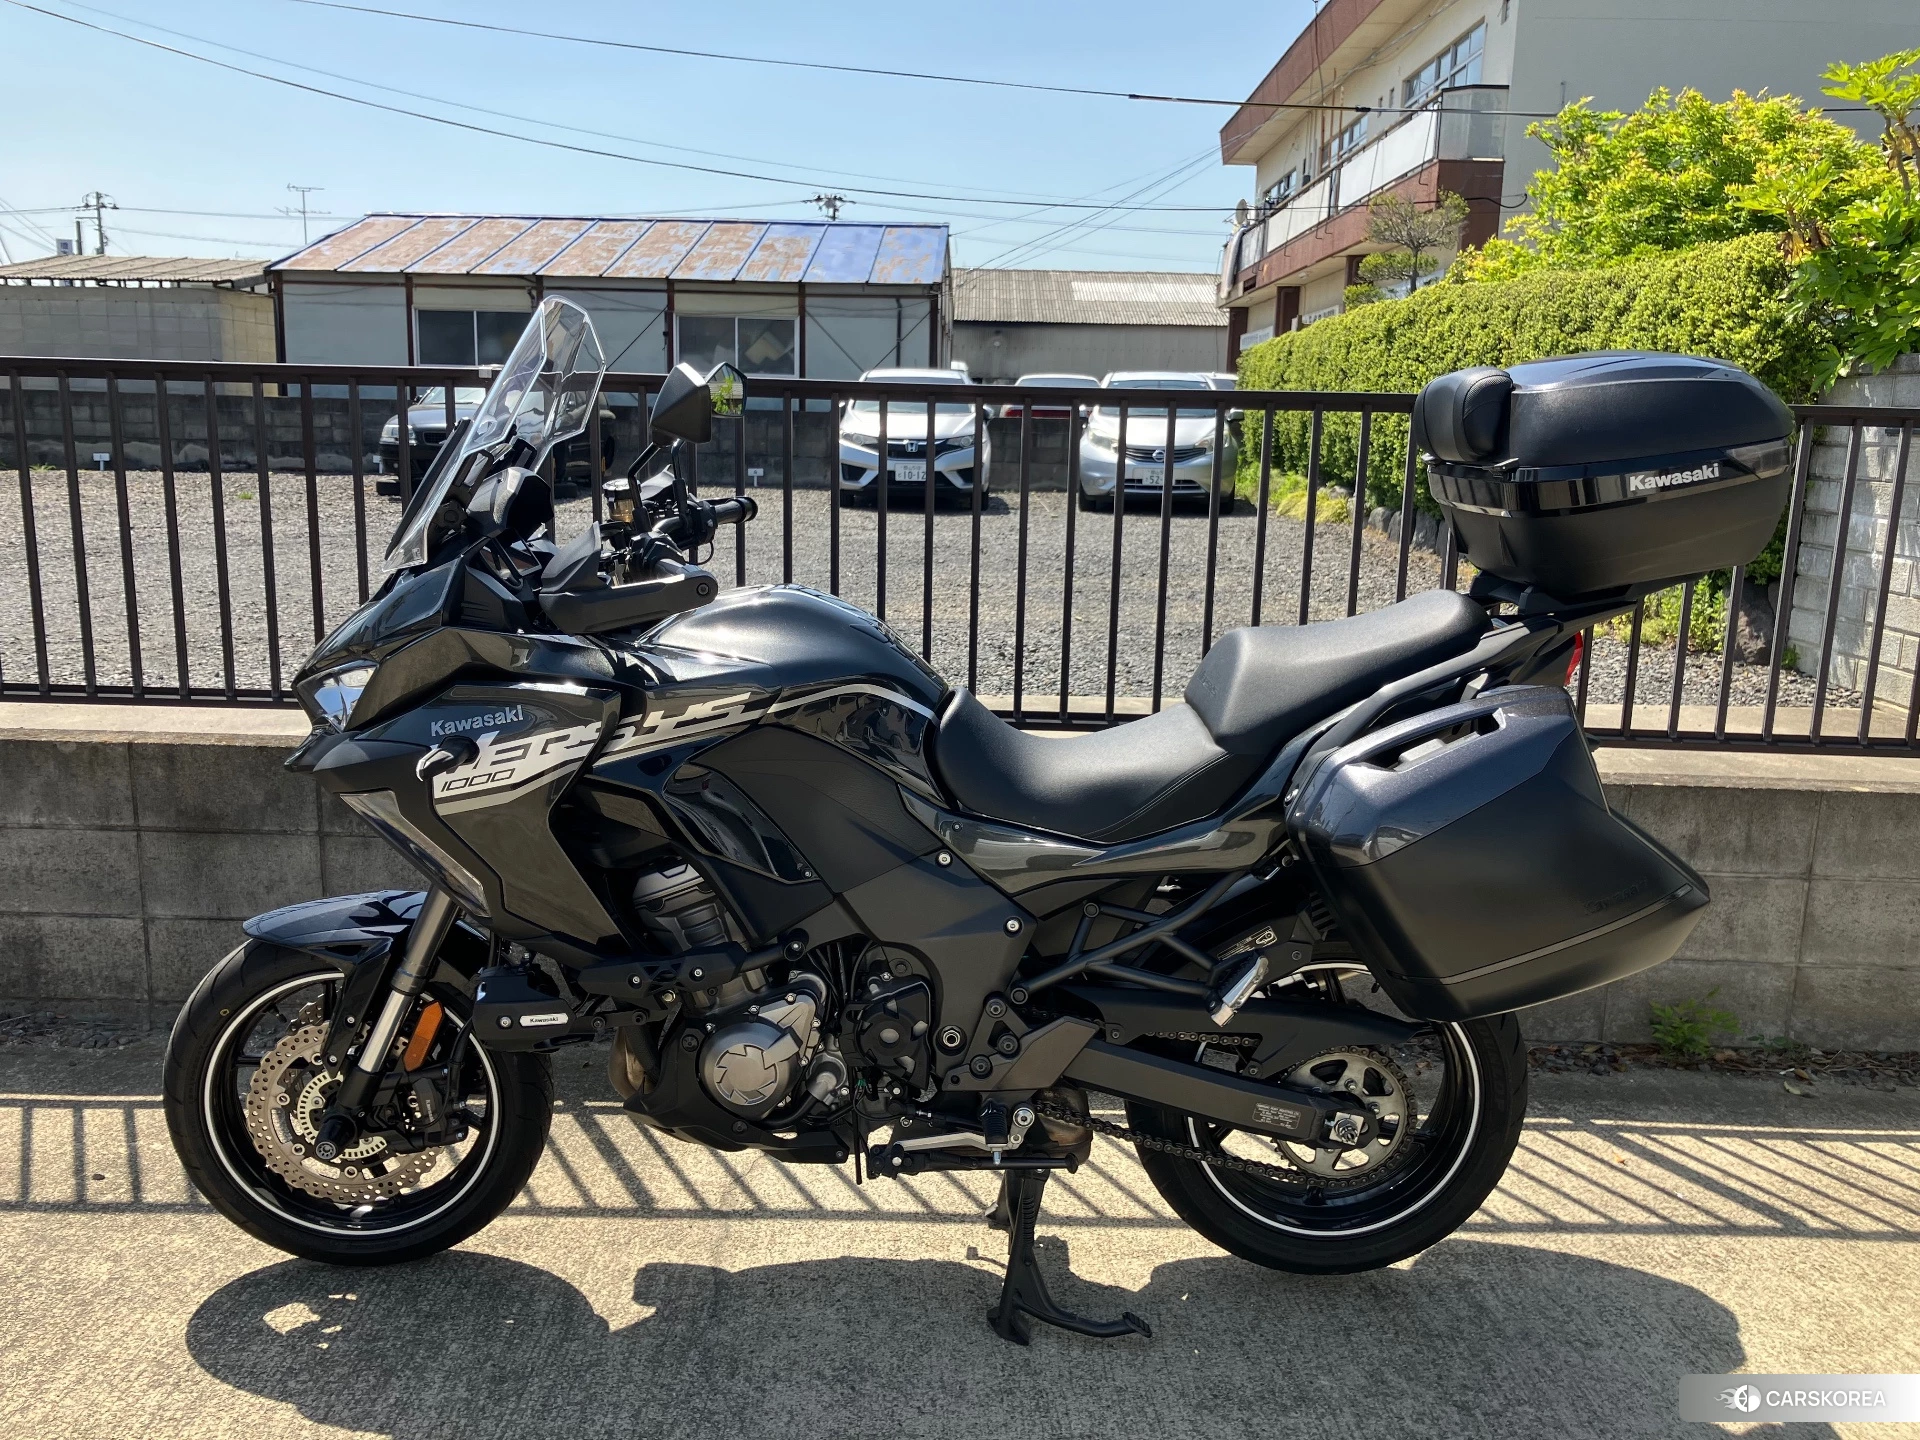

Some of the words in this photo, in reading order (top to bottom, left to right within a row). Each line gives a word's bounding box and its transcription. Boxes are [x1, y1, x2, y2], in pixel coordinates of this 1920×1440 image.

[1629, 463, 1719, 491] Kawasaki
[430, 704, 524, 737] Kawasaki
[440, 767, 516, 792] 1000
